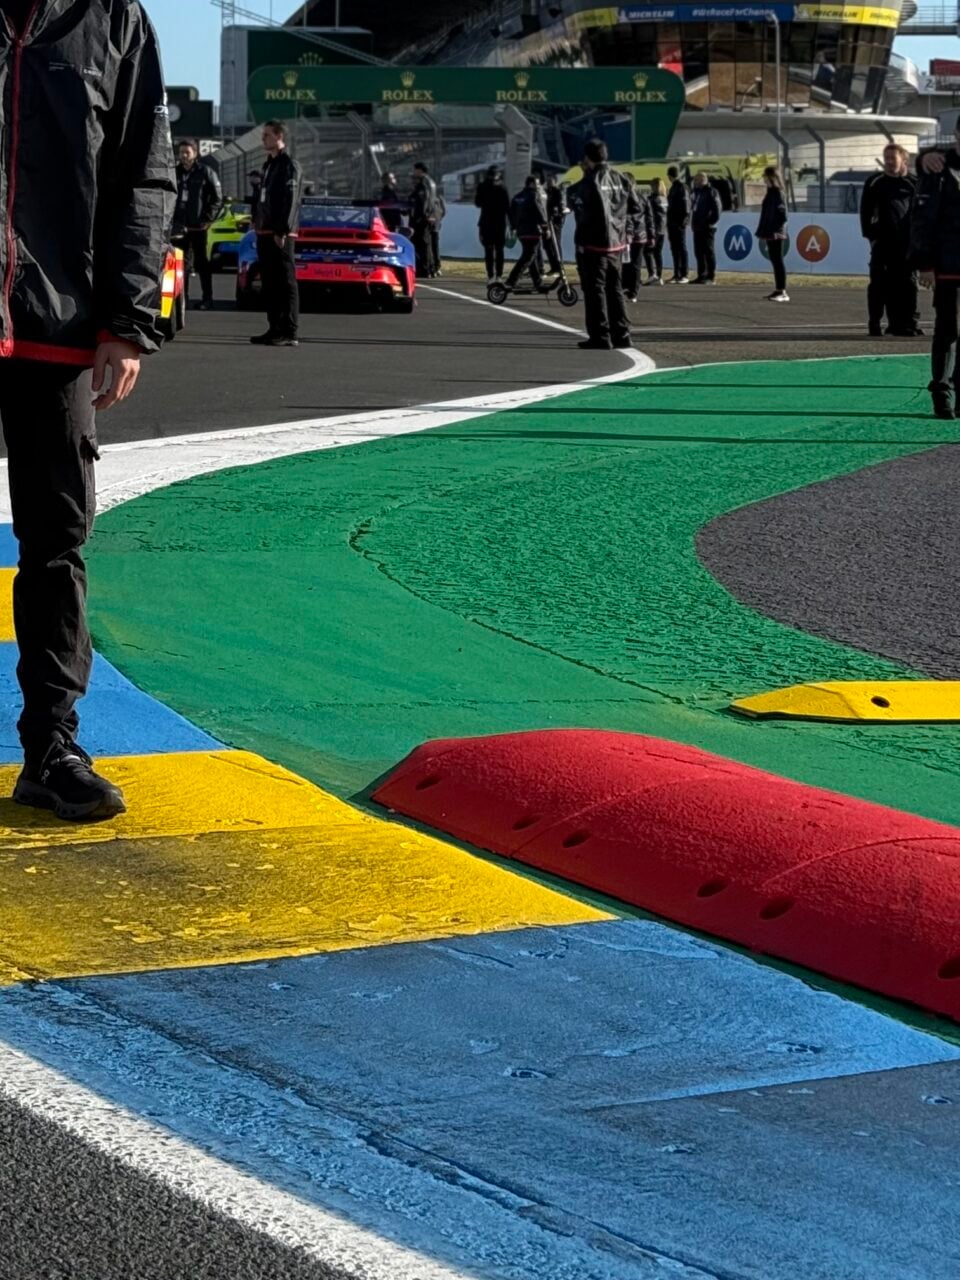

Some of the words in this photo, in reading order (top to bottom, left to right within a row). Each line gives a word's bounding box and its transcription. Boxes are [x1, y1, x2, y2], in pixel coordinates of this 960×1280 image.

[628, 9, 675, 18] MICHELIN
[812, 9, 858, 18] MICHELIN
[264, 89, 317, 101] ROLEX
[381, 89, 434, 102] ROLEX
[495, 90, 548, 102] ROLEX
[614, 90, 667, 103] ROLEX
[728, 235, 746, 250] M
[806, 235, 821, 251] A
